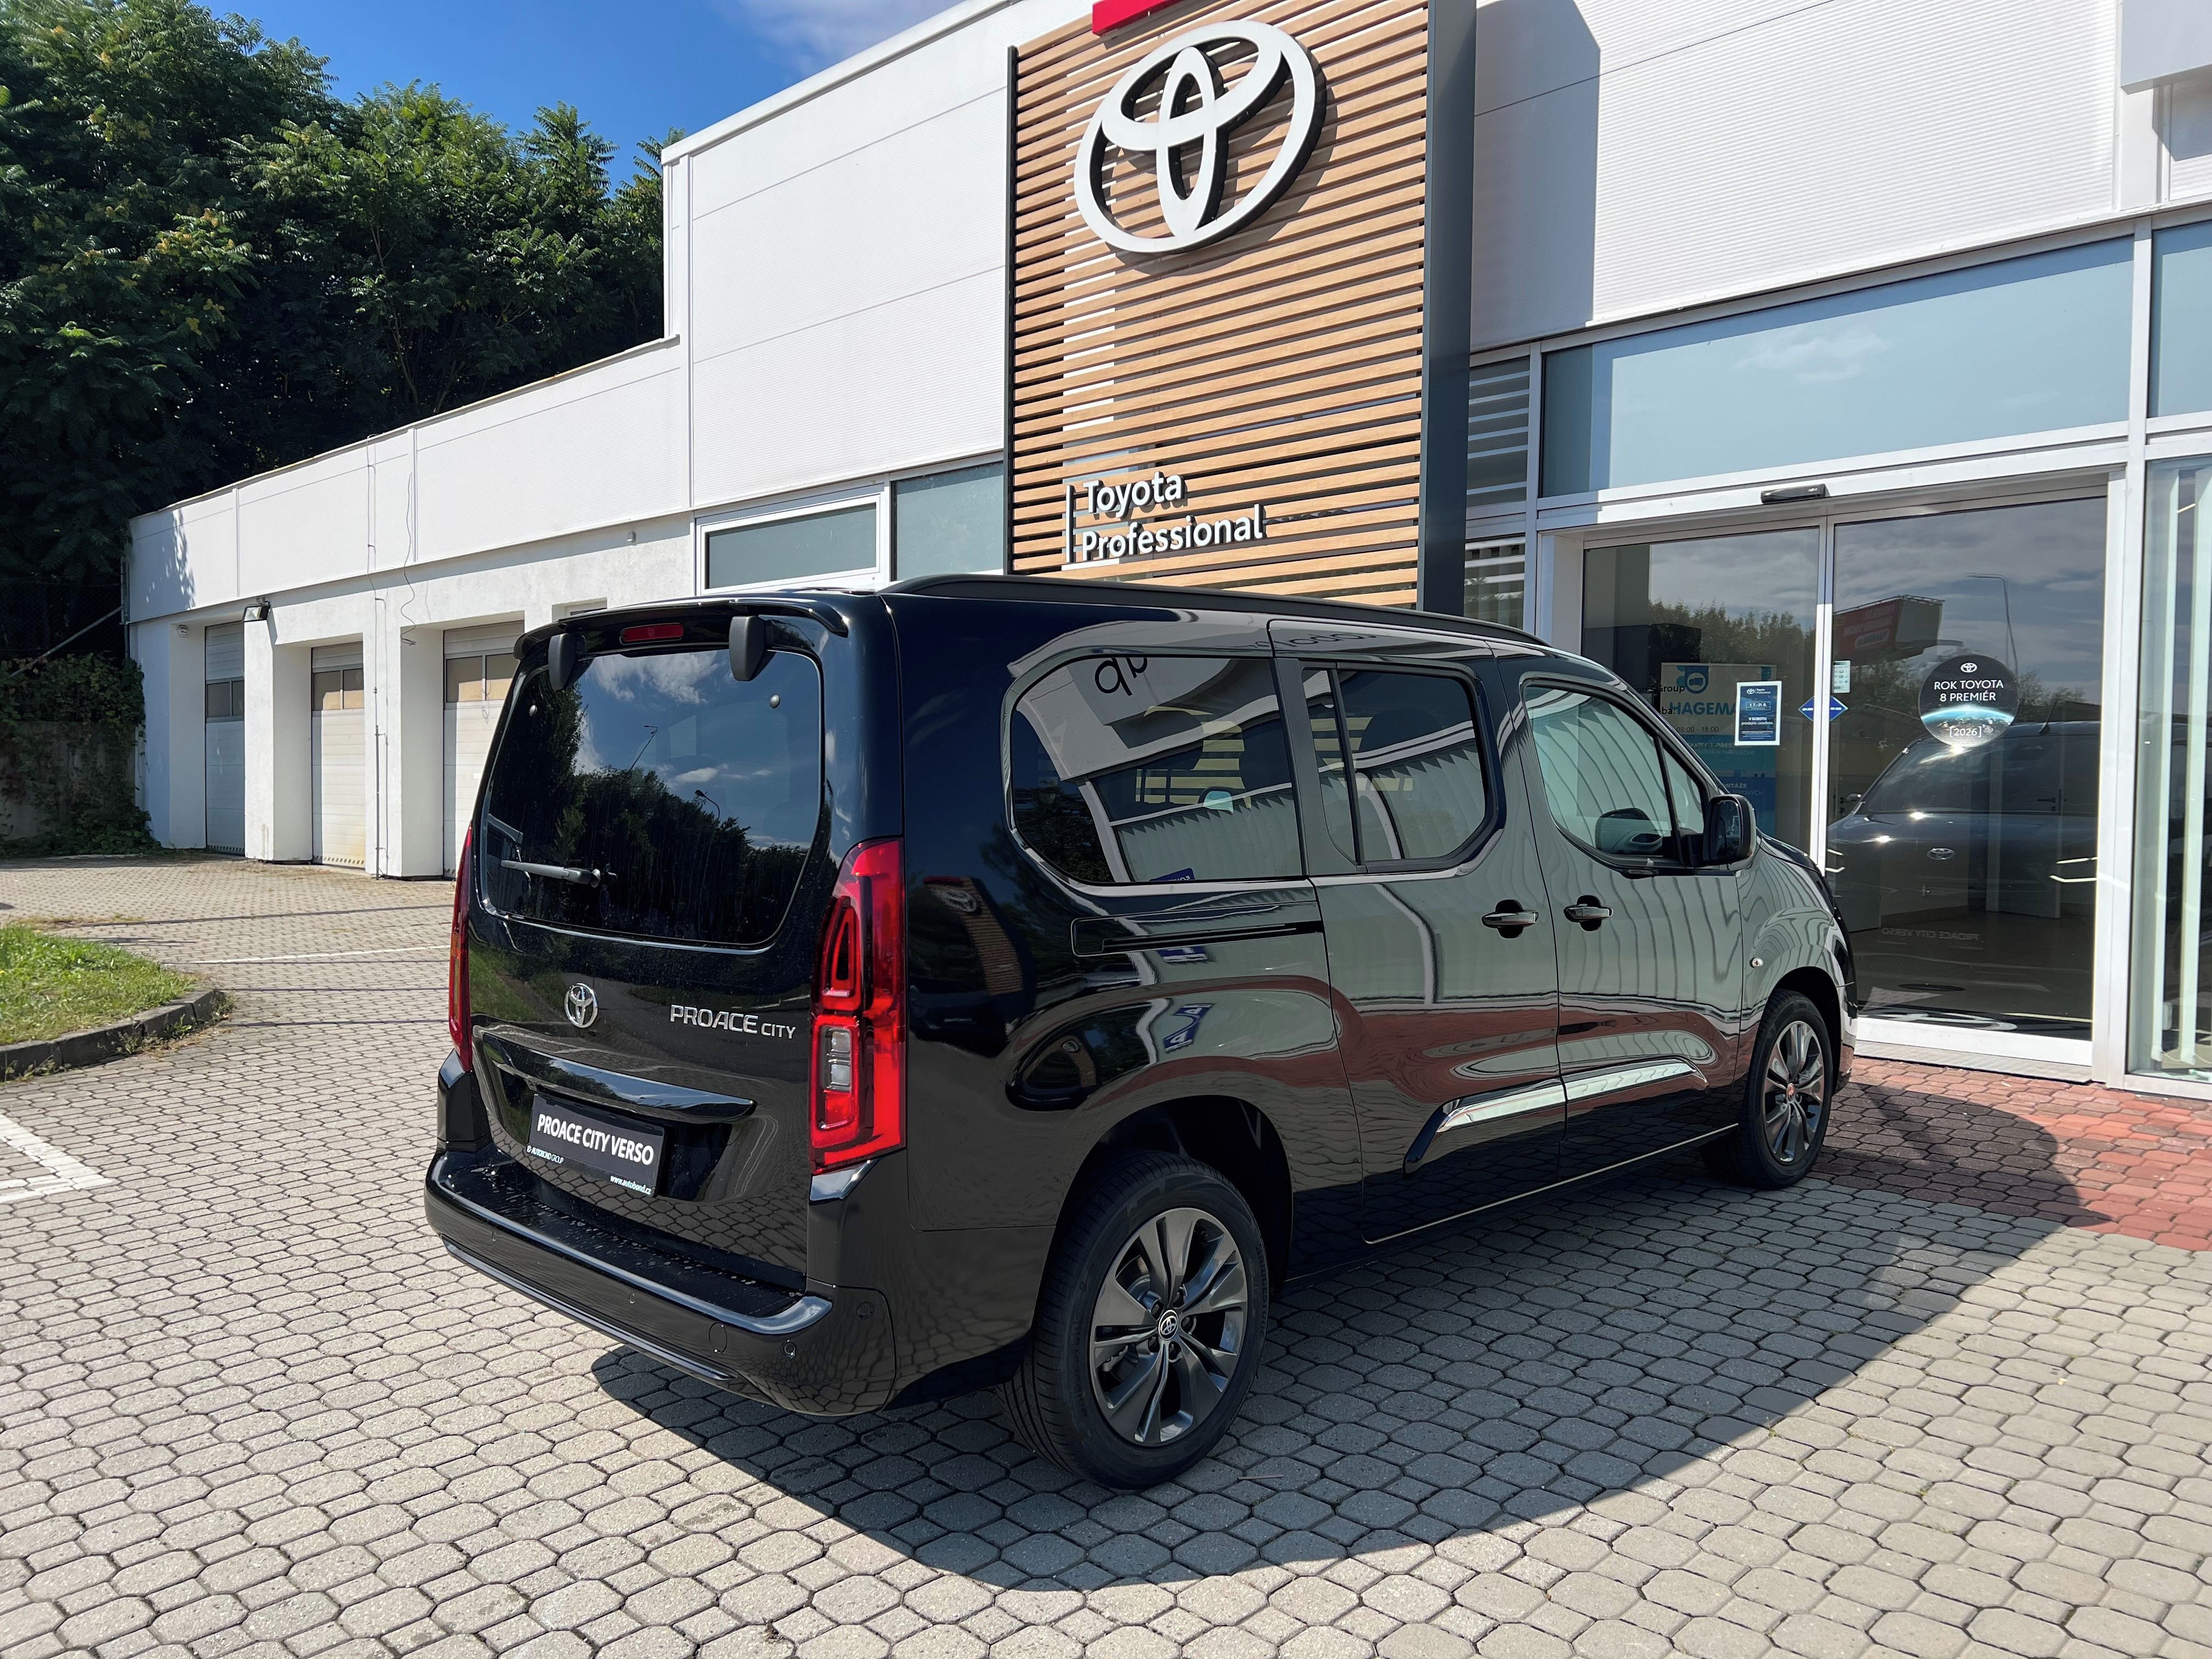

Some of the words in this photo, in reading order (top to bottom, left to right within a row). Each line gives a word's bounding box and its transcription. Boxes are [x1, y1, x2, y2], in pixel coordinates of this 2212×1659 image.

[1083, 471, 1185, 518] Toyota
[1082, 504, 1264, 561] Professional
[1934, 681, 1957, 690] ROK
[1960, 680, 2004, 689] TOYOTA
[1940, 693, 1946, 702] 8
[1950, 690, 1996, 702] PREMIÉR
[1949, 726, 1982, 737] [2026]
[670, 1004, 759, 1034] PROACE
[761, 1023, 796, 1039] CITY
[537, 1113, 582, 1144] PROACE
[583, 1128, 611, 1152] CITY
[611, 1135, 654, 1166] VERSO
[531, 1146, 551, 1160] AUTOBOND
[551, 1155, 564, 1164] GROUP
[610, 1175, 652, 1195] www.autobond.cz
